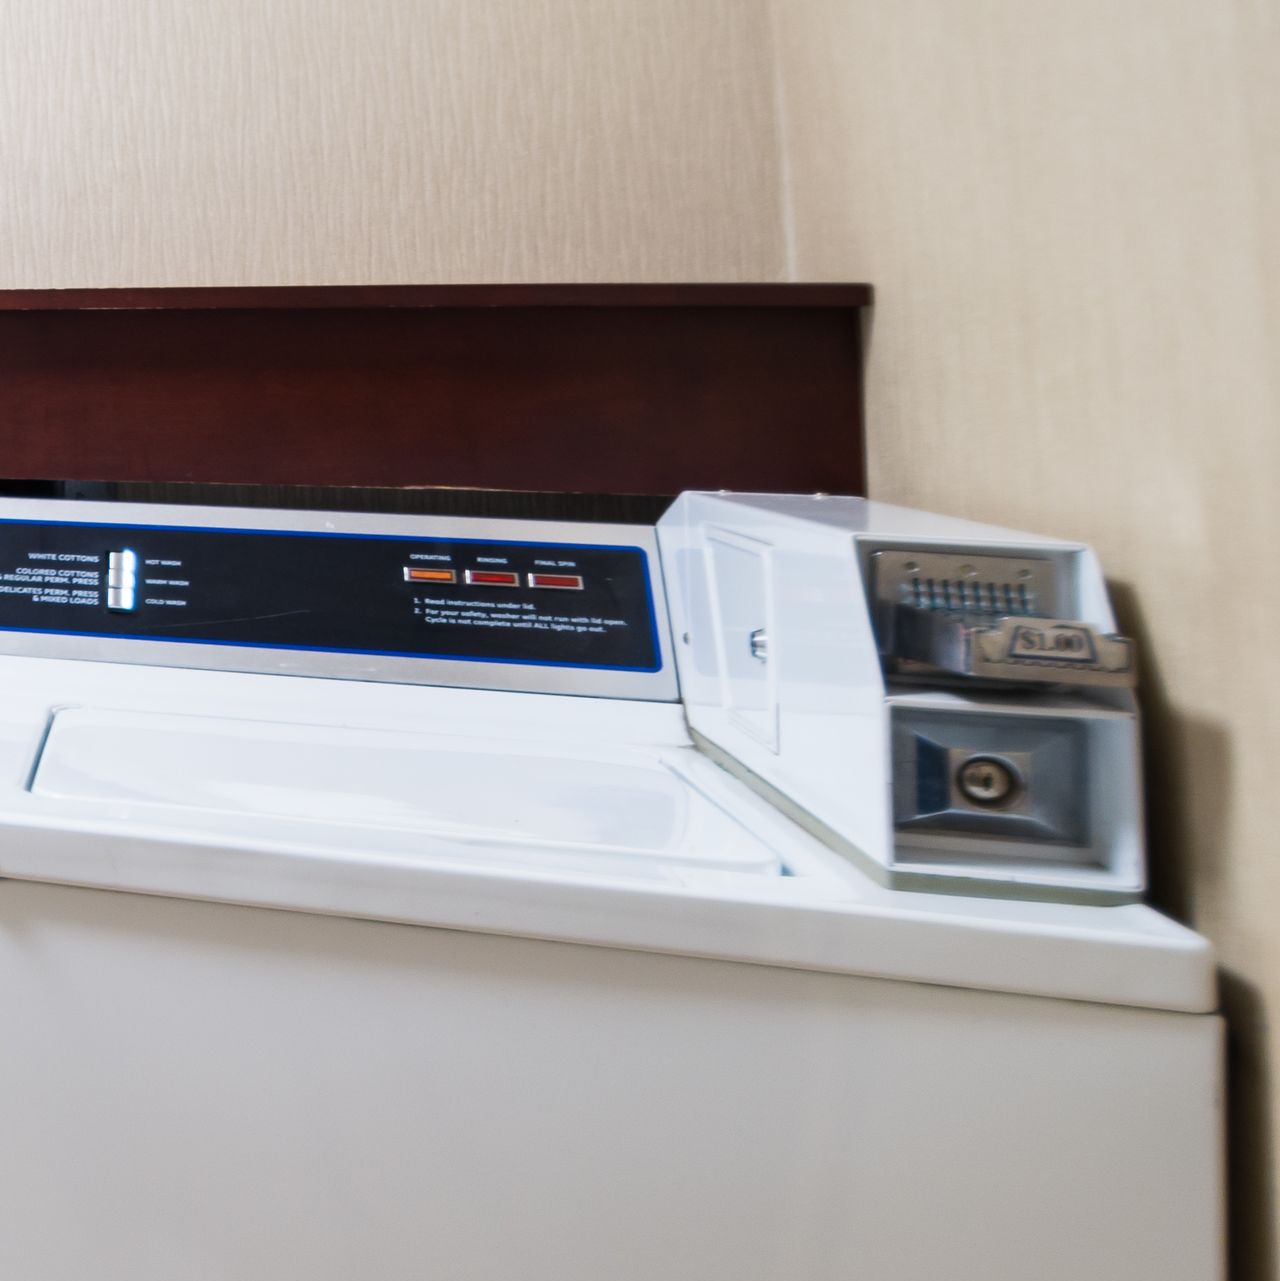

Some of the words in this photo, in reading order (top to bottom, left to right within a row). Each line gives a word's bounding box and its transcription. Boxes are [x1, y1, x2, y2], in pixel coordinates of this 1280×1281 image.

[28, 553, 57, 561] WHITE
[58, 554, 99, 563] COTTONS
[15, 567, 57, 576] COLORED
[58, 570, 99, 578] COTTONS
[3, 574, 43, 582] REGULAR
[44, 576, 71, 584] PERM.
[72, 577, 99, 586] PRESS
[44, 588, 71, 596] PERM.
[72, 590, 99, 598] PRESS
[40, 596, 68, 604] MIXED
[69, 597, 99, 606] LOADS
[446, 599, 496, 608] instructions
[425, 616, 447, 624] Cycle
